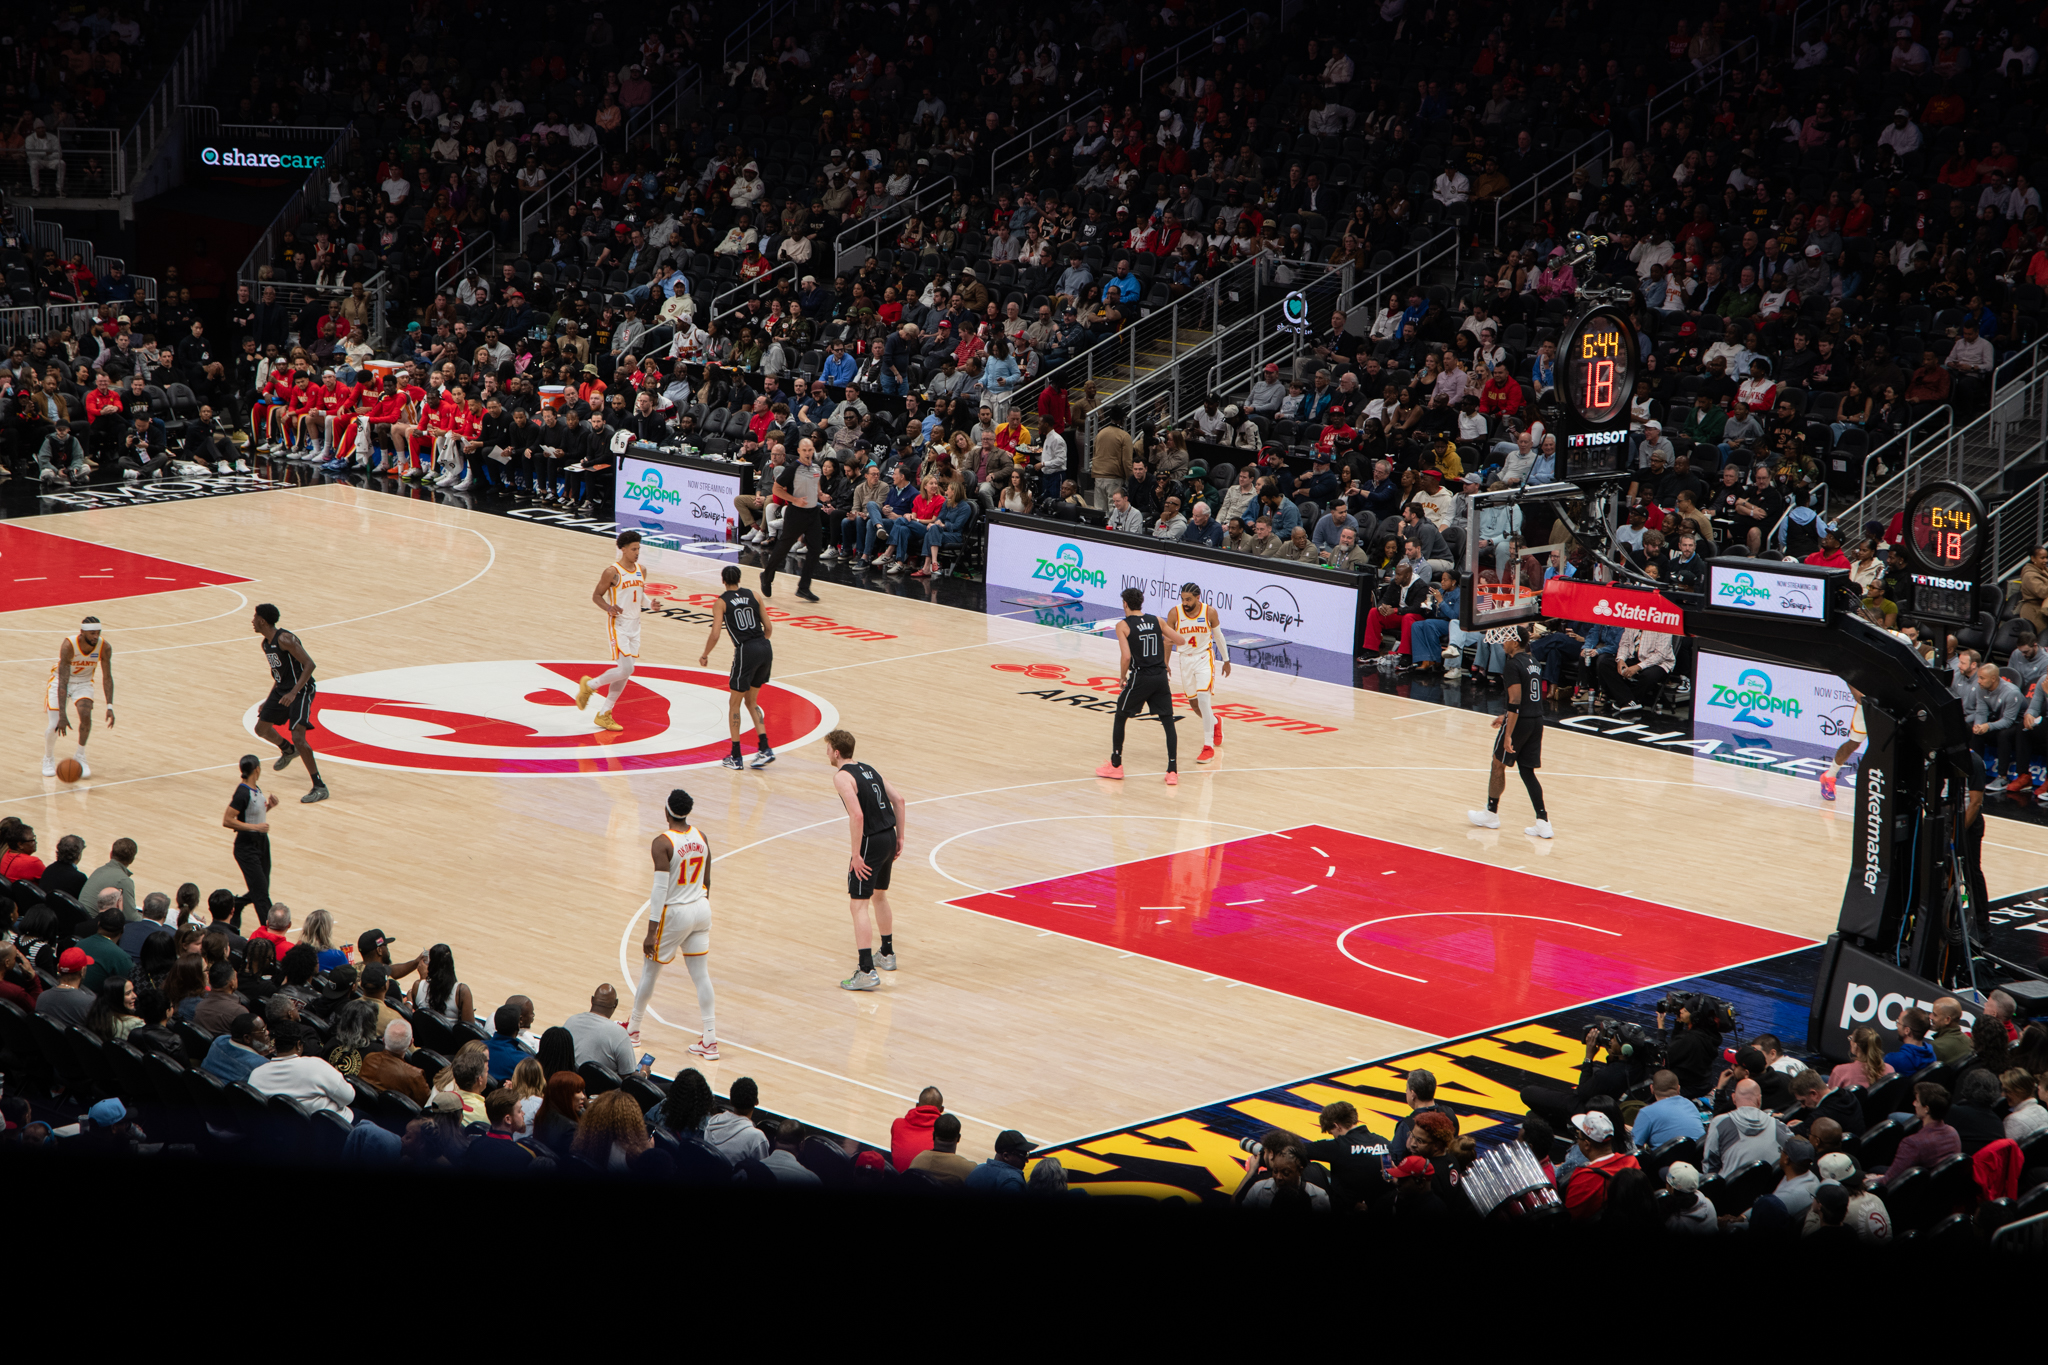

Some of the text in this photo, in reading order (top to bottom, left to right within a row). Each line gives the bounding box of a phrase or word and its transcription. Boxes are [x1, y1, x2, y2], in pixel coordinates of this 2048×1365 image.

[222, 147, 325, 169] sharecare
[1583, 332, 1619, 359] 6:44
[1586, 360, 1614, 408] 18
[1585, 430, 1628, 446] TISSOT
[687, 480, 733, 495] NOW STREAMING ON
[1932, 507, 1971, 531] 6:44
[1937, 531, 1962, 560] 18
[1031, 558, 1107, 589] ZOOTOPIA
[1788, 582, 1811, 590] STREAMING
[1927, 575, 1973, 592] TISSOT
[632, 589, 637, 602] 1
[1150, 580, 1213, 607] STREANG
[1216, 591, 1233, 611] ON
[733, 606, 756, 631] 00
[1139, 633, 1158, 657] 77
[1187, 635, 1197, 648] 4
[1529, 677, 1541, 702] 9
[1707, 683, 1803, 719] ZOOTOPIA
[1814, 686, 1832, 698] NOW
[871, 783, 886, 810] 2
[1863, 768, 1886, 895] ticketmaster
[677, 856, 705, 886] 17
